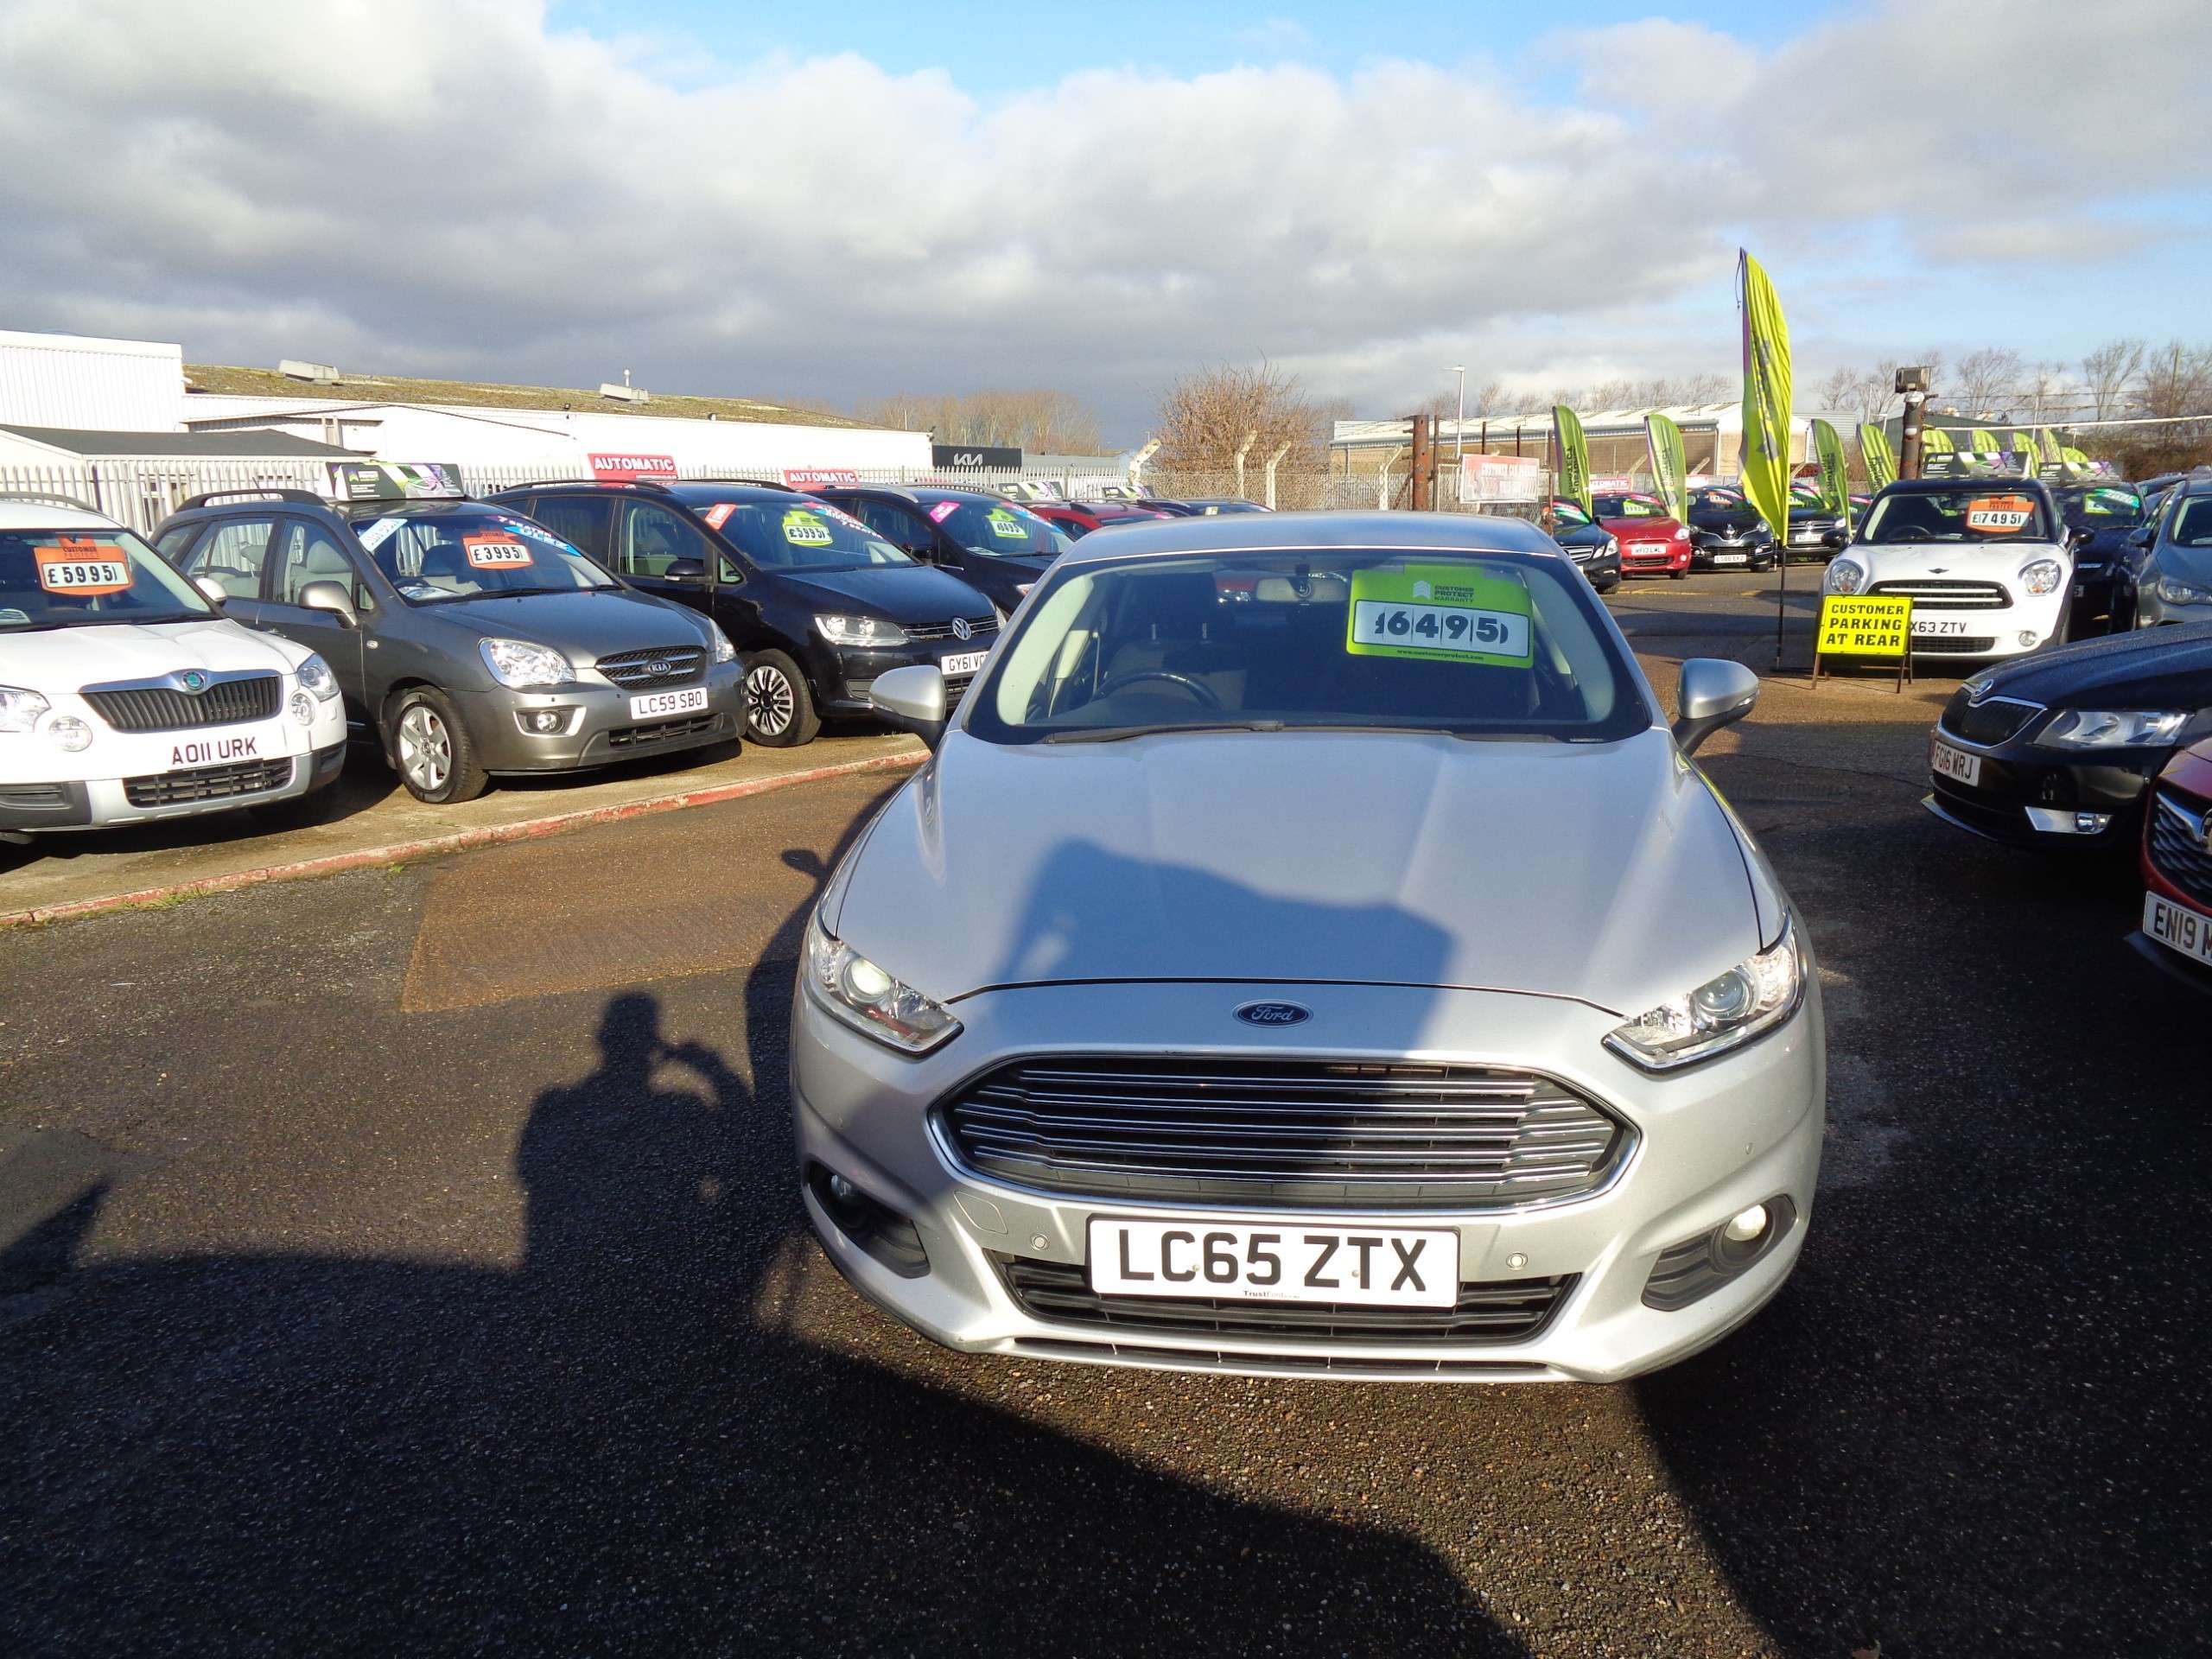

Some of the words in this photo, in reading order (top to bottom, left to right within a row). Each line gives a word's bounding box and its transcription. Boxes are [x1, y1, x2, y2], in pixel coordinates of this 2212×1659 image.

[594, 456, 674, 472] AUTOMATIC
[954, 453, 983, 466] KIA
[788, 472, 856, 484] AUTOMATIC
[1831, 604, 1904, 615] CUSTOMER
[1829, 618, 1903, 631] PARKING
[1826, 633, 1848, 645] AT
[1854, 634, 1901, 647] REAR
[949, 657, 971, 671] GY61
[639, 696, 676, 715] LC59
[679, 691, 702, 708] SBO
[172, 742, 212, 765] AO11
[218, 736, 257, 759] URK
[1953, 752, 1974, 779] WRJ
[2154, 901, 2196, 950] EN19
[1251, 1005, 1294, 1020] Ford
[1119, 1229, 1281, 1286] LC65
[1304, 1235, 1427, 1292] ZTX
